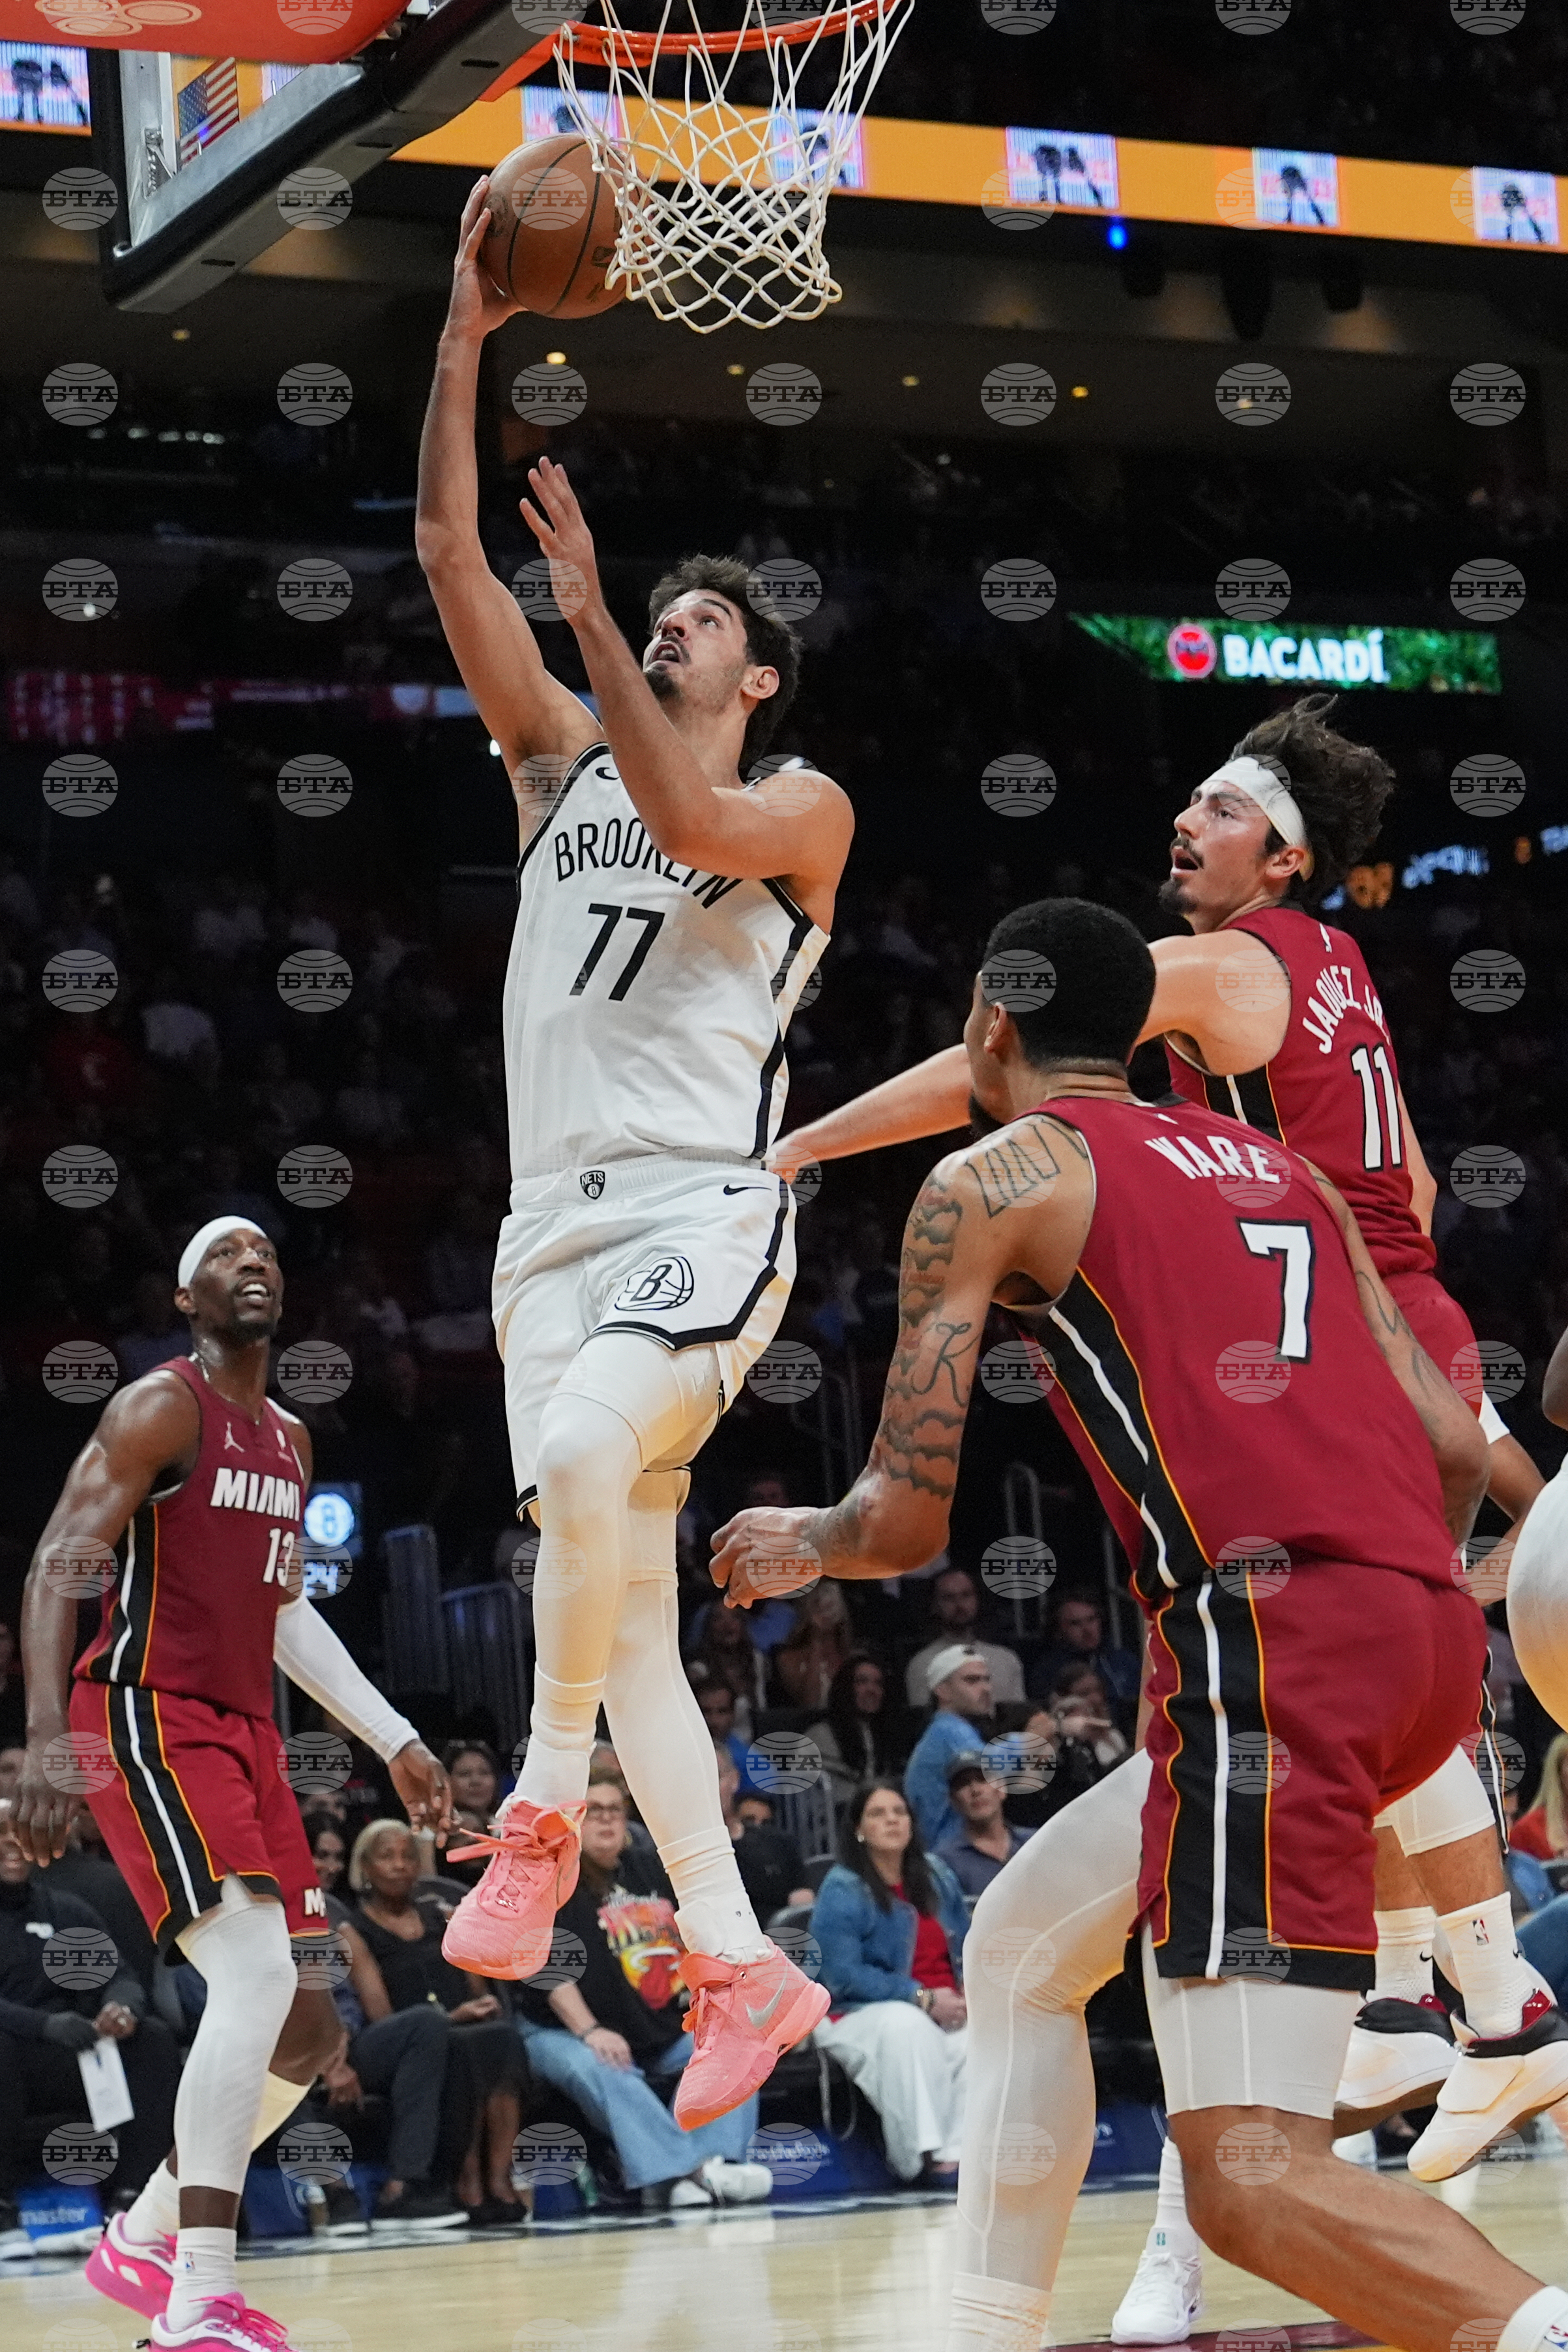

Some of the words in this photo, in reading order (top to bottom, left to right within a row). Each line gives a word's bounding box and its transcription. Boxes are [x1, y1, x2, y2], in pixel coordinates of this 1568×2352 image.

[1223, 628, 1386, 683] BACARDÍ
[569, 903, 666, 1002] 77
[1302, 965, 1362, 1054] JAQUEZ
[1350, 1043, 1402, 1172] 11
[581, 1172, 605, 1187] NETS
[1144, 1136, 1281, 1184] WARE
[630, 1264, 673, 1301] B
[1236, 1218, 1314, 1363] 7
[210, 1466, 300, 1522] MIAMI
[262, 1527, 295, 1588] 13
[303, 1562, 339, 1597] 24
